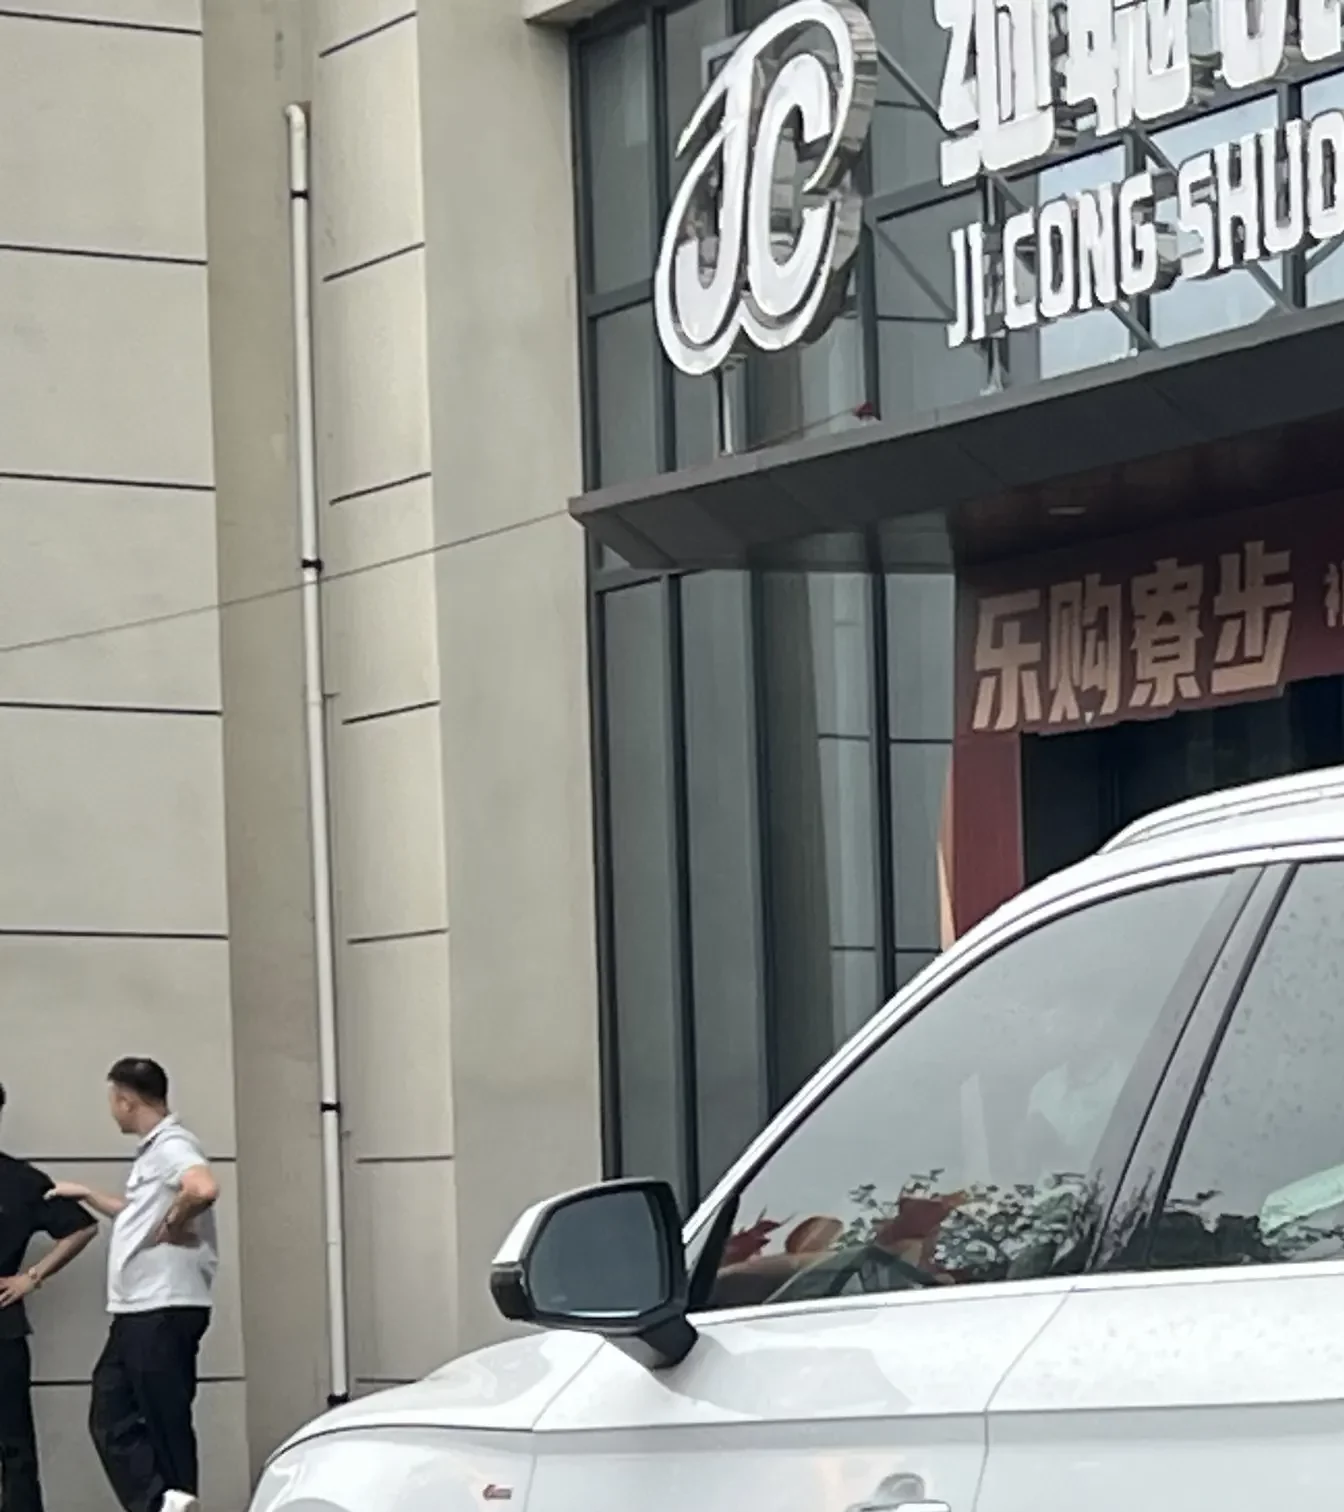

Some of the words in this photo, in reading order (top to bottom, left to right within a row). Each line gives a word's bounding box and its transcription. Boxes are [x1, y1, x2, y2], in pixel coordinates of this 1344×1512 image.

[946, 221, 987, 348] JI
[1003, 171, 1158, 330] CONG
[972, 539, 1294, 731] 乐购寮步
